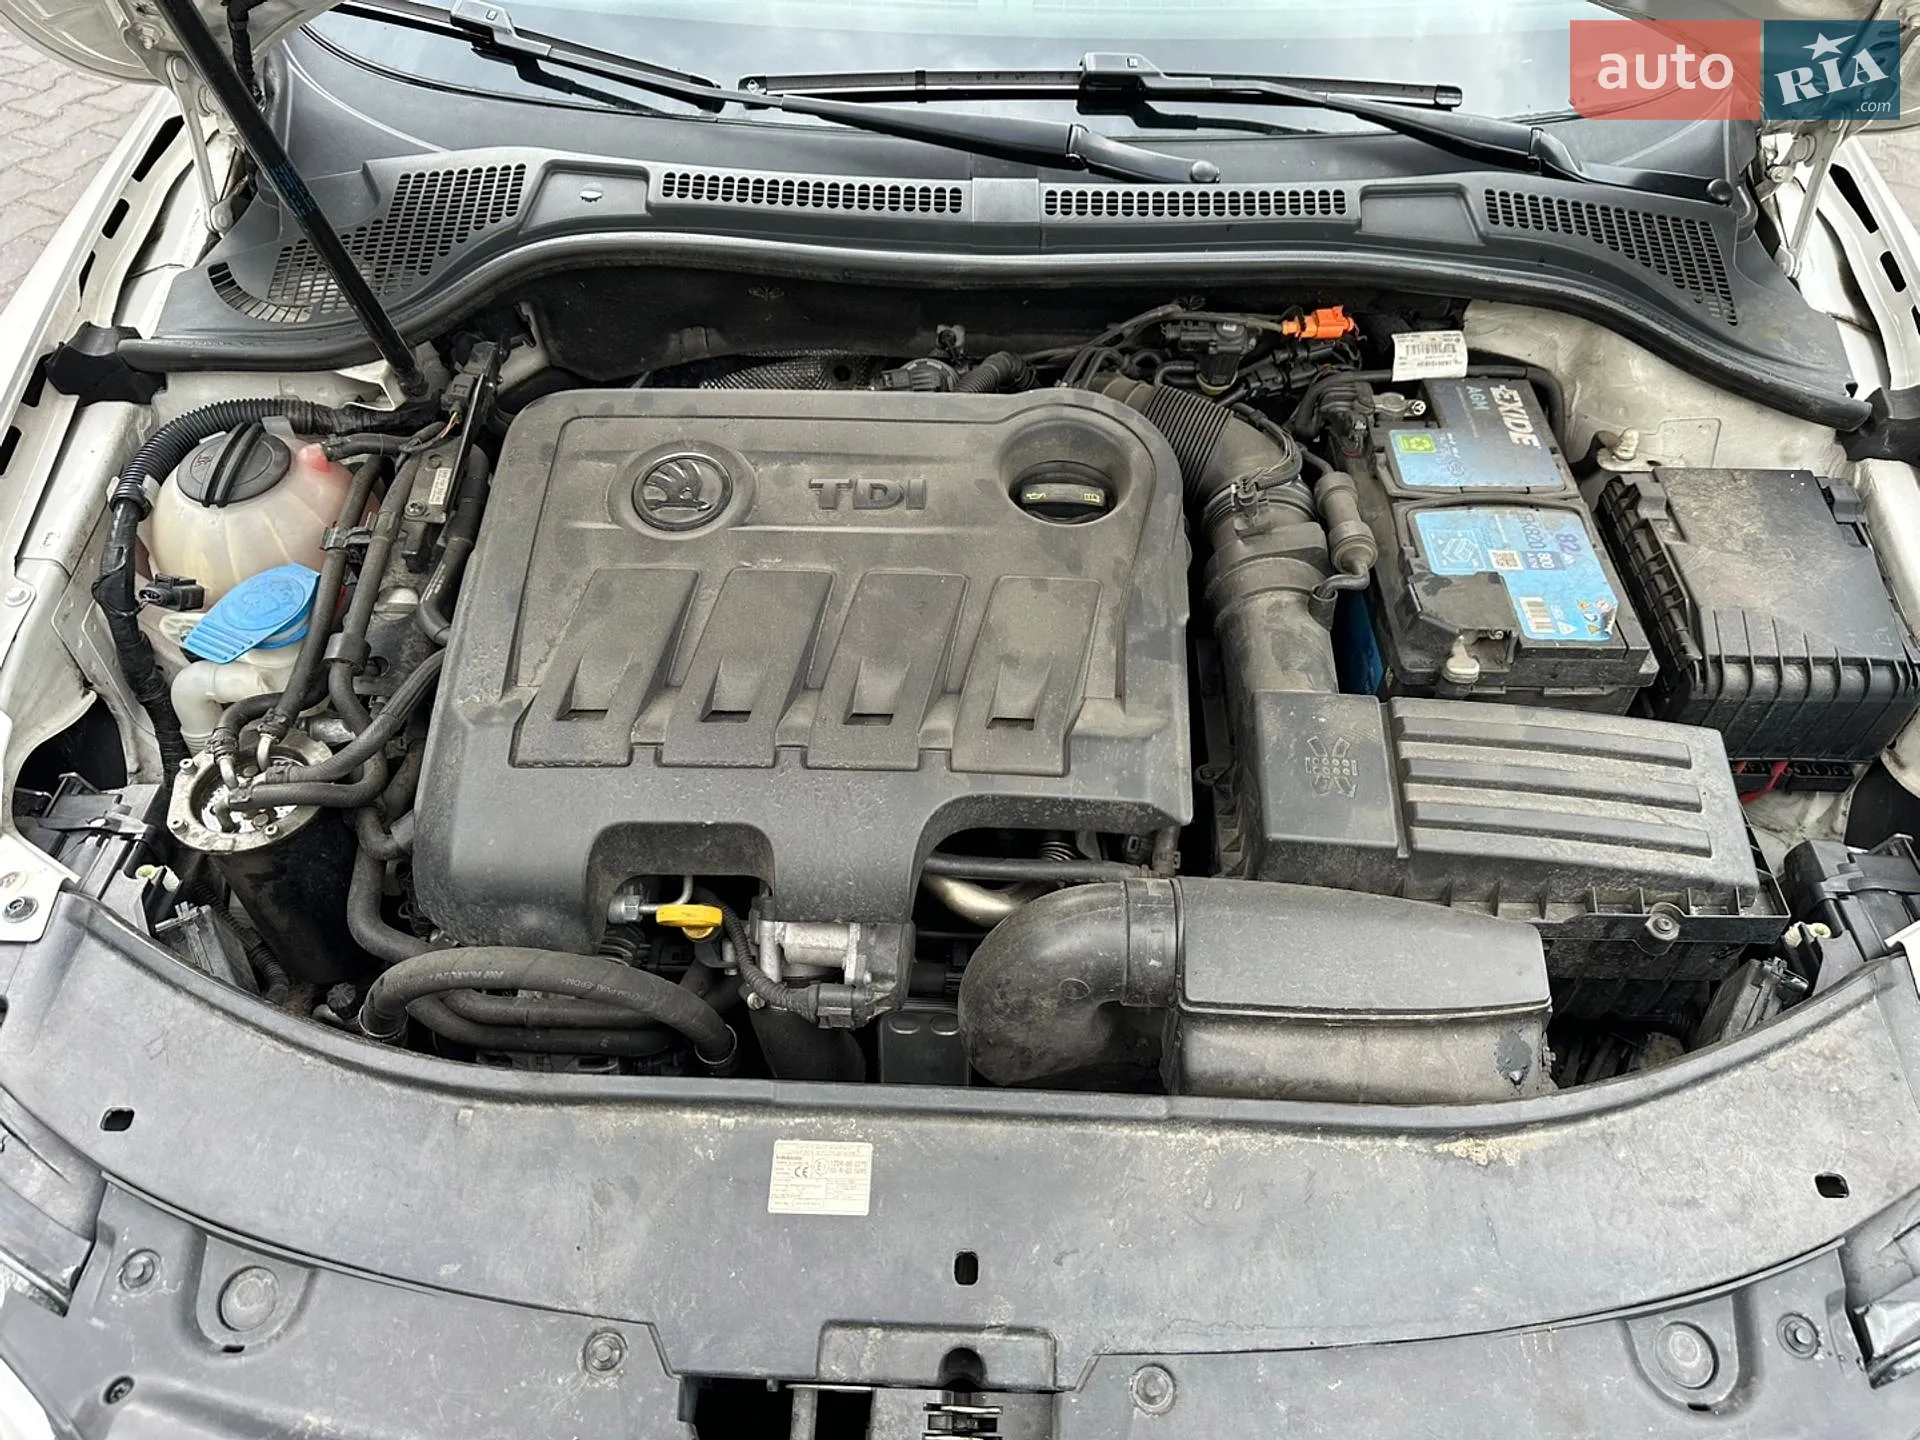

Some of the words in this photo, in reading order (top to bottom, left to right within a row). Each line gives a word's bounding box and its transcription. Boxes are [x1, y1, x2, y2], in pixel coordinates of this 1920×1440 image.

[1466, 385, 1490, 411] AGM
[1490, 384, 1541, 449] EXIDE
[808, 479, 927, 510] TDI
[1555, 533, 1581, 555] 82
[1537, 551, 1555, 569] 800
